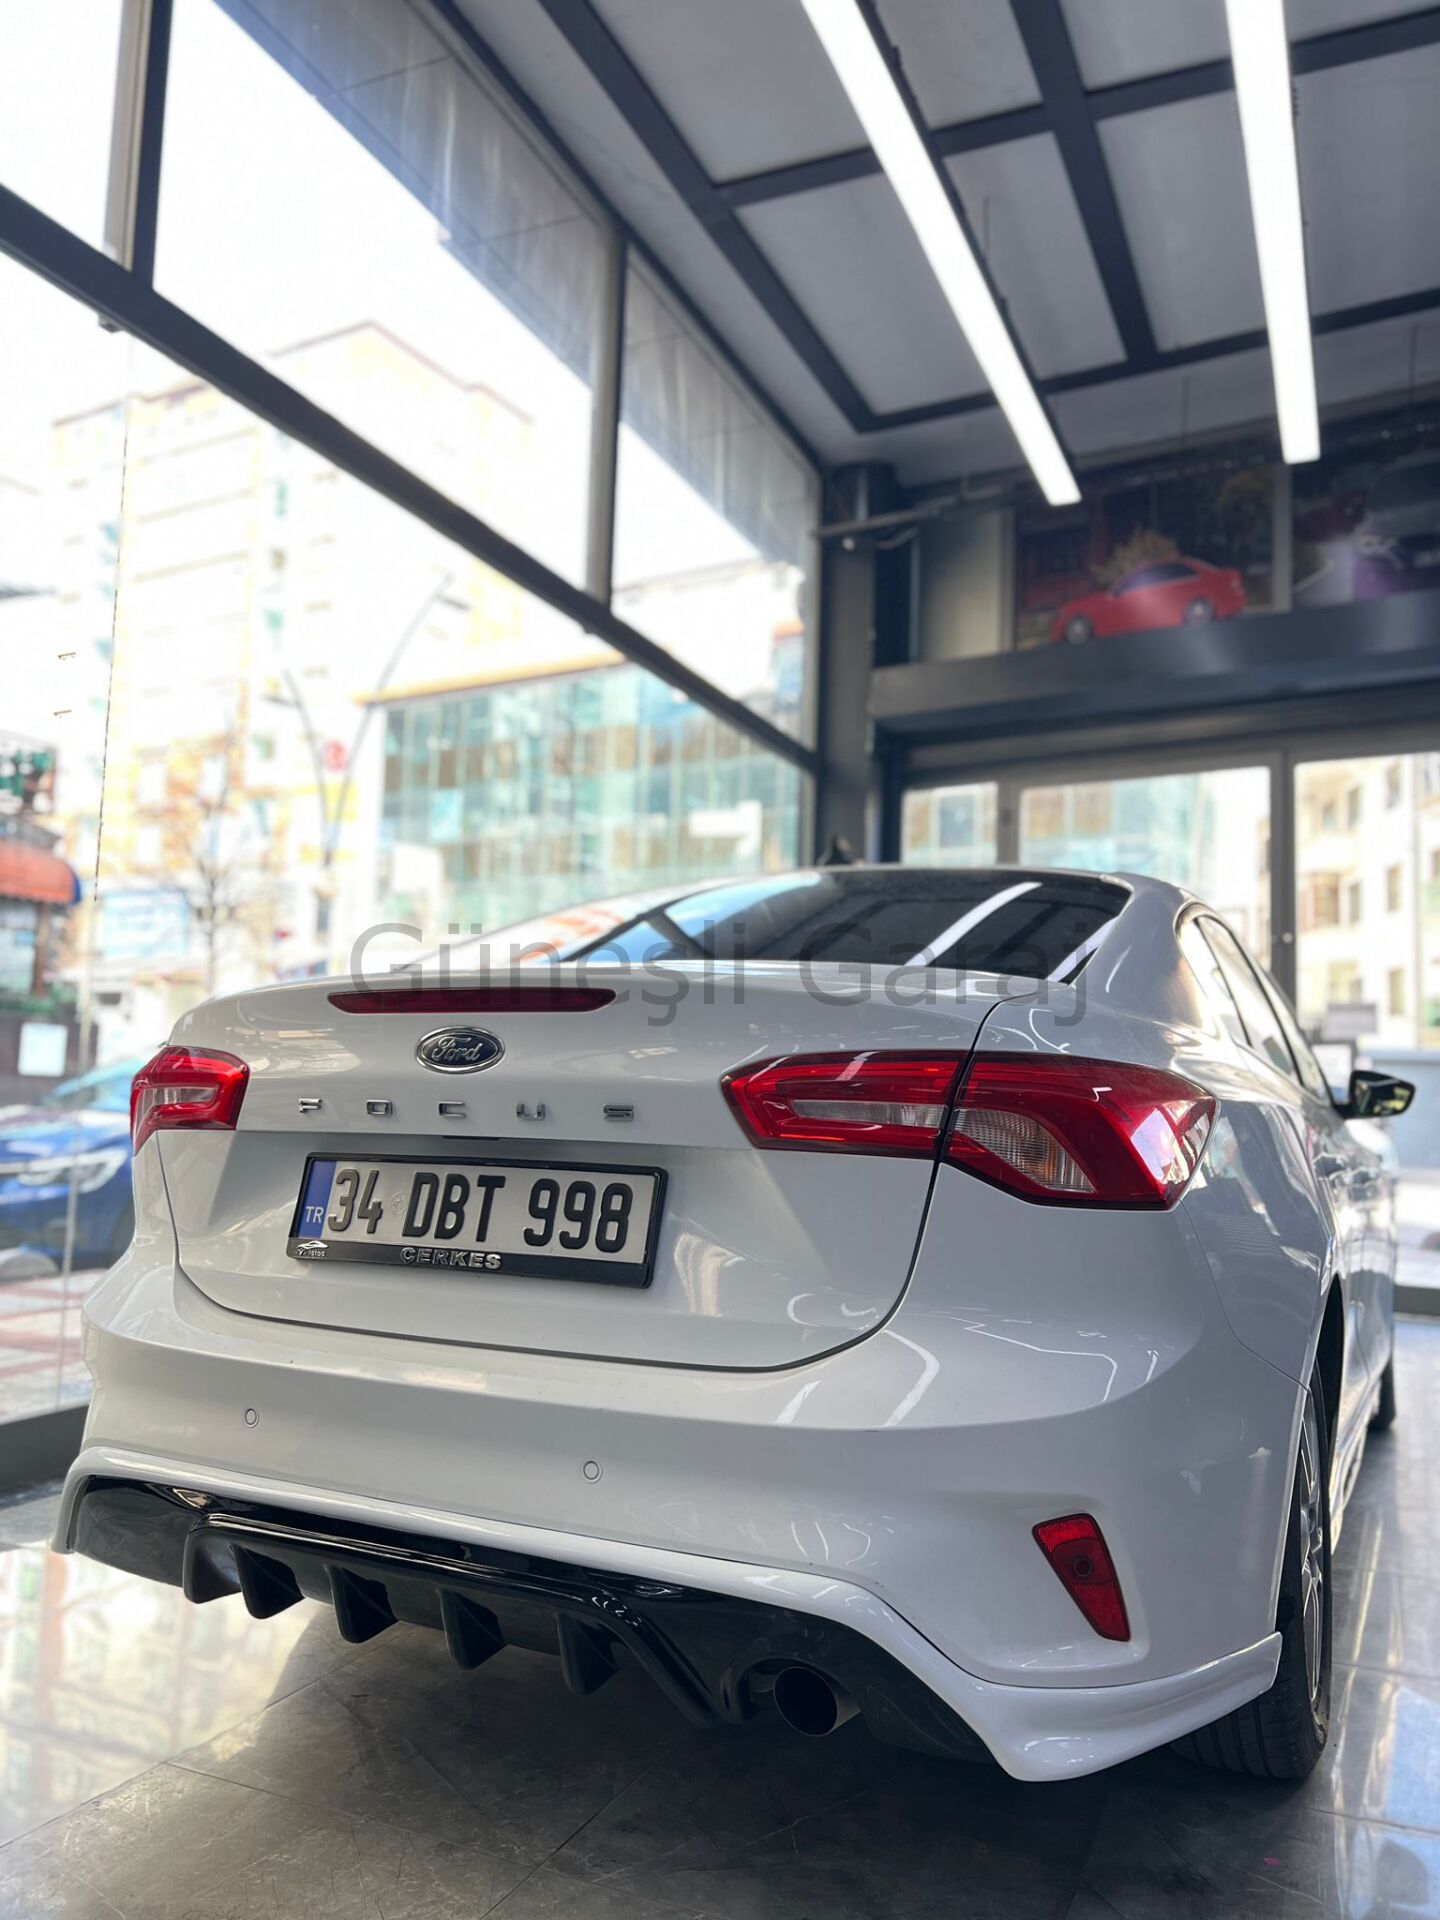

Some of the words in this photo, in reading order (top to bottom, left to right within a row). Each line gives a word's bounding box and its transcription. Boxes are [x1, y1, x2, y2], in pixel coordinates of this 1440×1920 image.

[432, 1037, 482, 1062] Ford
[299, 1098, 635, 1122] FOCUS
[305, 1205, 324, 1224] TR
[327, 1168, 383, 1234] 34
[402, 1171, 506, 1242] DBT
[523, 1178, 634, 1253] 998
